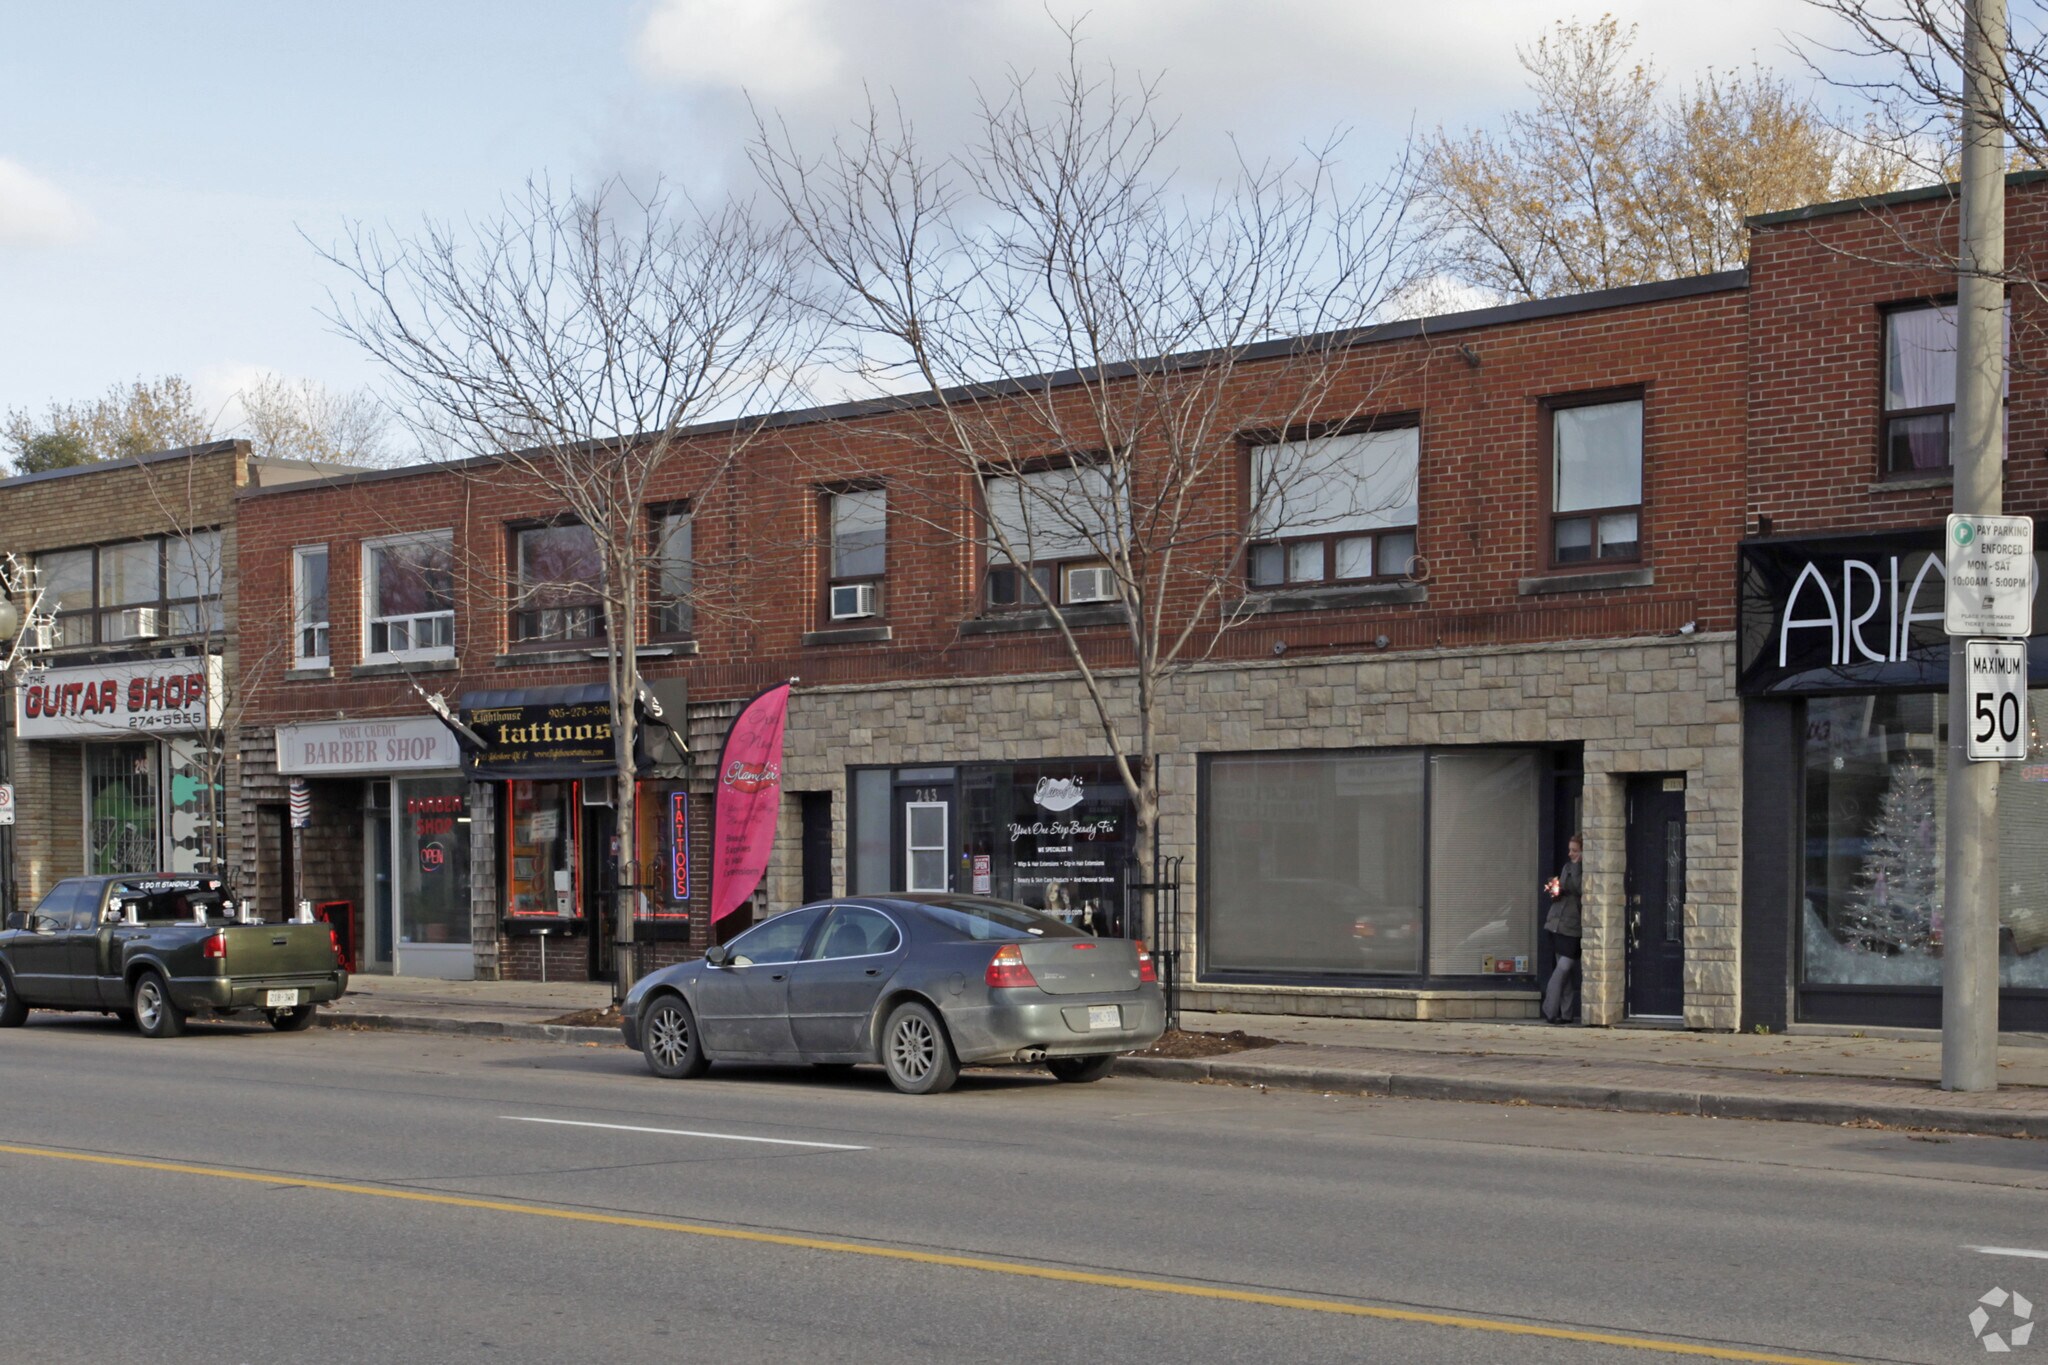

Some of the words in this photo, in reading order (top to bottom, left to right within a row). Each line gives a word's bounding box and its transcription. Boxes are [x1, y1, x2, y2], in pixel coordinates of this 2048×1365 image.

[1976, 524, 1991, 536] PAY
[1993, 524, 2028, 537] PARKING
[1981, 543, 2023, 555] ENFORCED
[1967, 560, 1987, 571] MON
[1994, 560, 2011, 571] SAT
[1952, 575, 1988, 587] 10:00AM
[1995, 577, 2026, 588] 5:00PM
[1973, 657, 2020, 675] MAXIMUM
[29, 675, 45, 684] THE
[26, 679, 118, 719] GUITAR
[127, 674, 205, 713] SHOP
[471, 711, 521, 725] Lighthouse
[548, 705, 611, 718] 905-278-596
[1975, 691, 2020, 743] 50
[129, 712, 202, 728] 274-5555
[339, 726, 361, 740] PORT
[364, 724, 397, 738] CREDIT
[498, 721, 612, 745] tattoos
[304, 740, 378, 765] BARBER
[386, 737, 437, 762] SHOP
[916, 788, 938, 802] 243
[407, 796, 462, 814] BARBER
[416, 818, 453, 835] SHOP
[1032, 821, 1049, 835] One
[1050, 821, 1069, 840] Stop
[1069, 820, 1096, 840] Beauty
[674, 795, 687, 895] TATTOOS
[420, 848, 444, 864] OPEN
[161, 880, 190, 889] STANDING
[190, 880, 201, 889] UP
